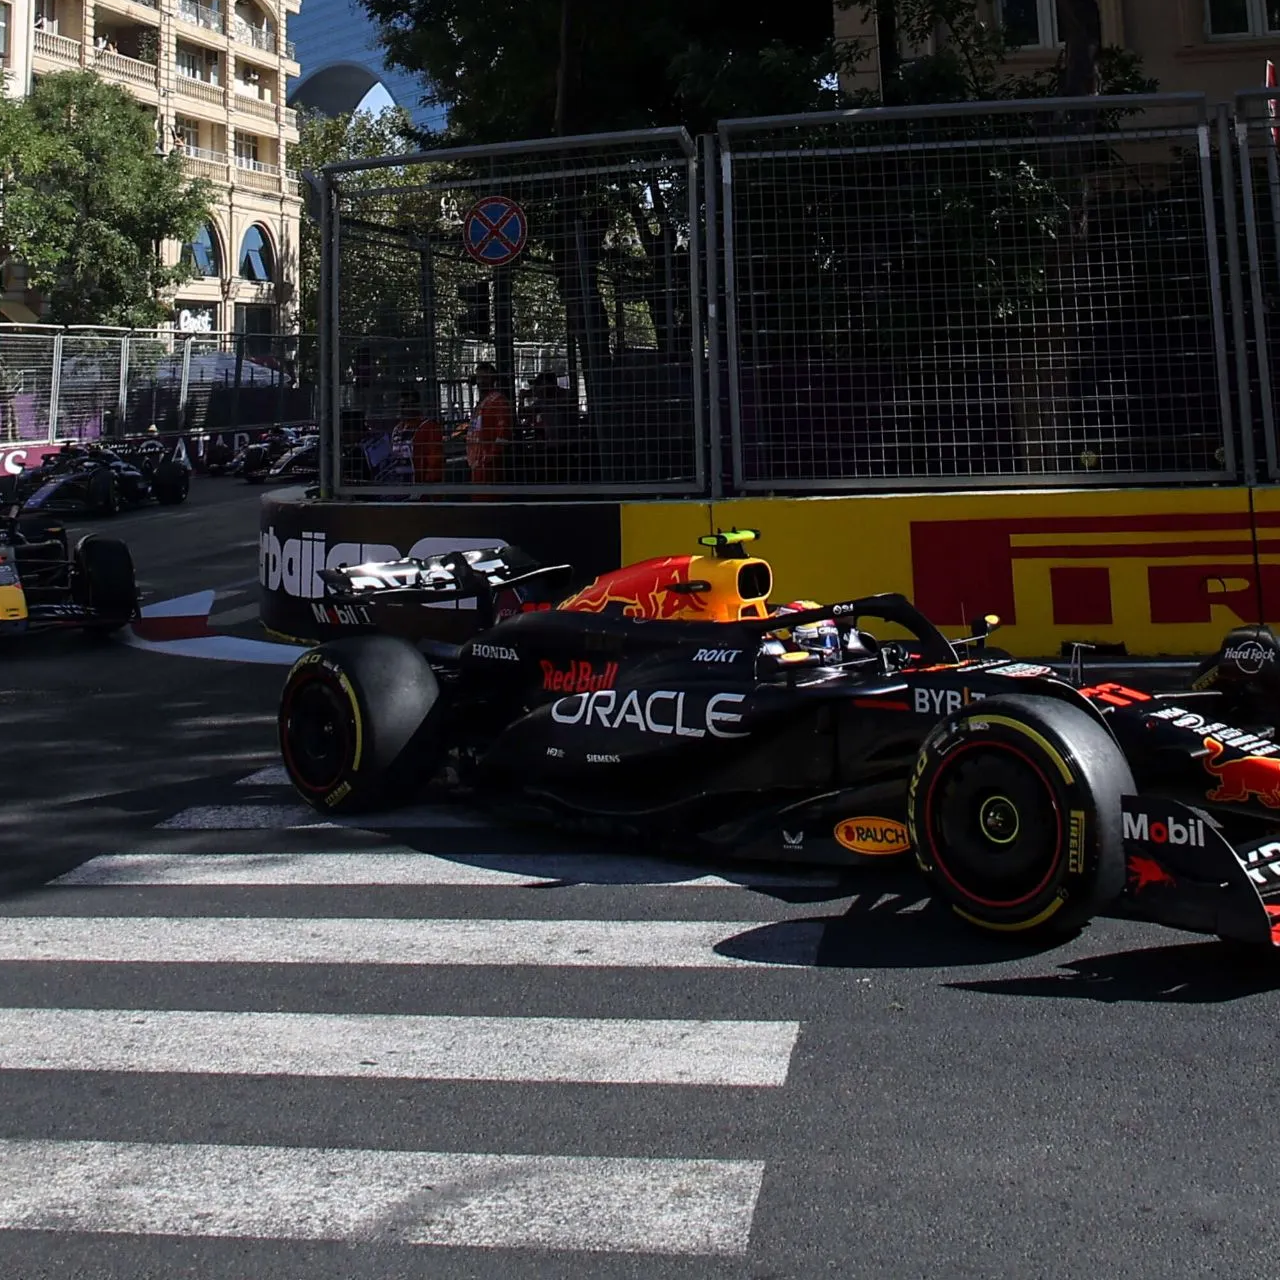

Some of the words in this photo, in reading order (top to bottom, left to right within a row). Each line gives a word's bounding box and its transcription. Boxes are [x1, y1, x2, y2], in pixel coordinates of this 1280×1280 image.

[311, 603, 359, 624] Mobil
[472, 644, 519, 661] HONDA
[692, 649, 743, 663] ROKT
[1225, 647, 1249, 660] Hard
[551, 689, 751, 738] ORACLE
[586, 753, 620, 763] SIEMENS
[855, 825, 908, 845] RAUCH
[1122, 811, 1206, 848] Mobil
[1068, 809, 1086, 875] PIRELLI
